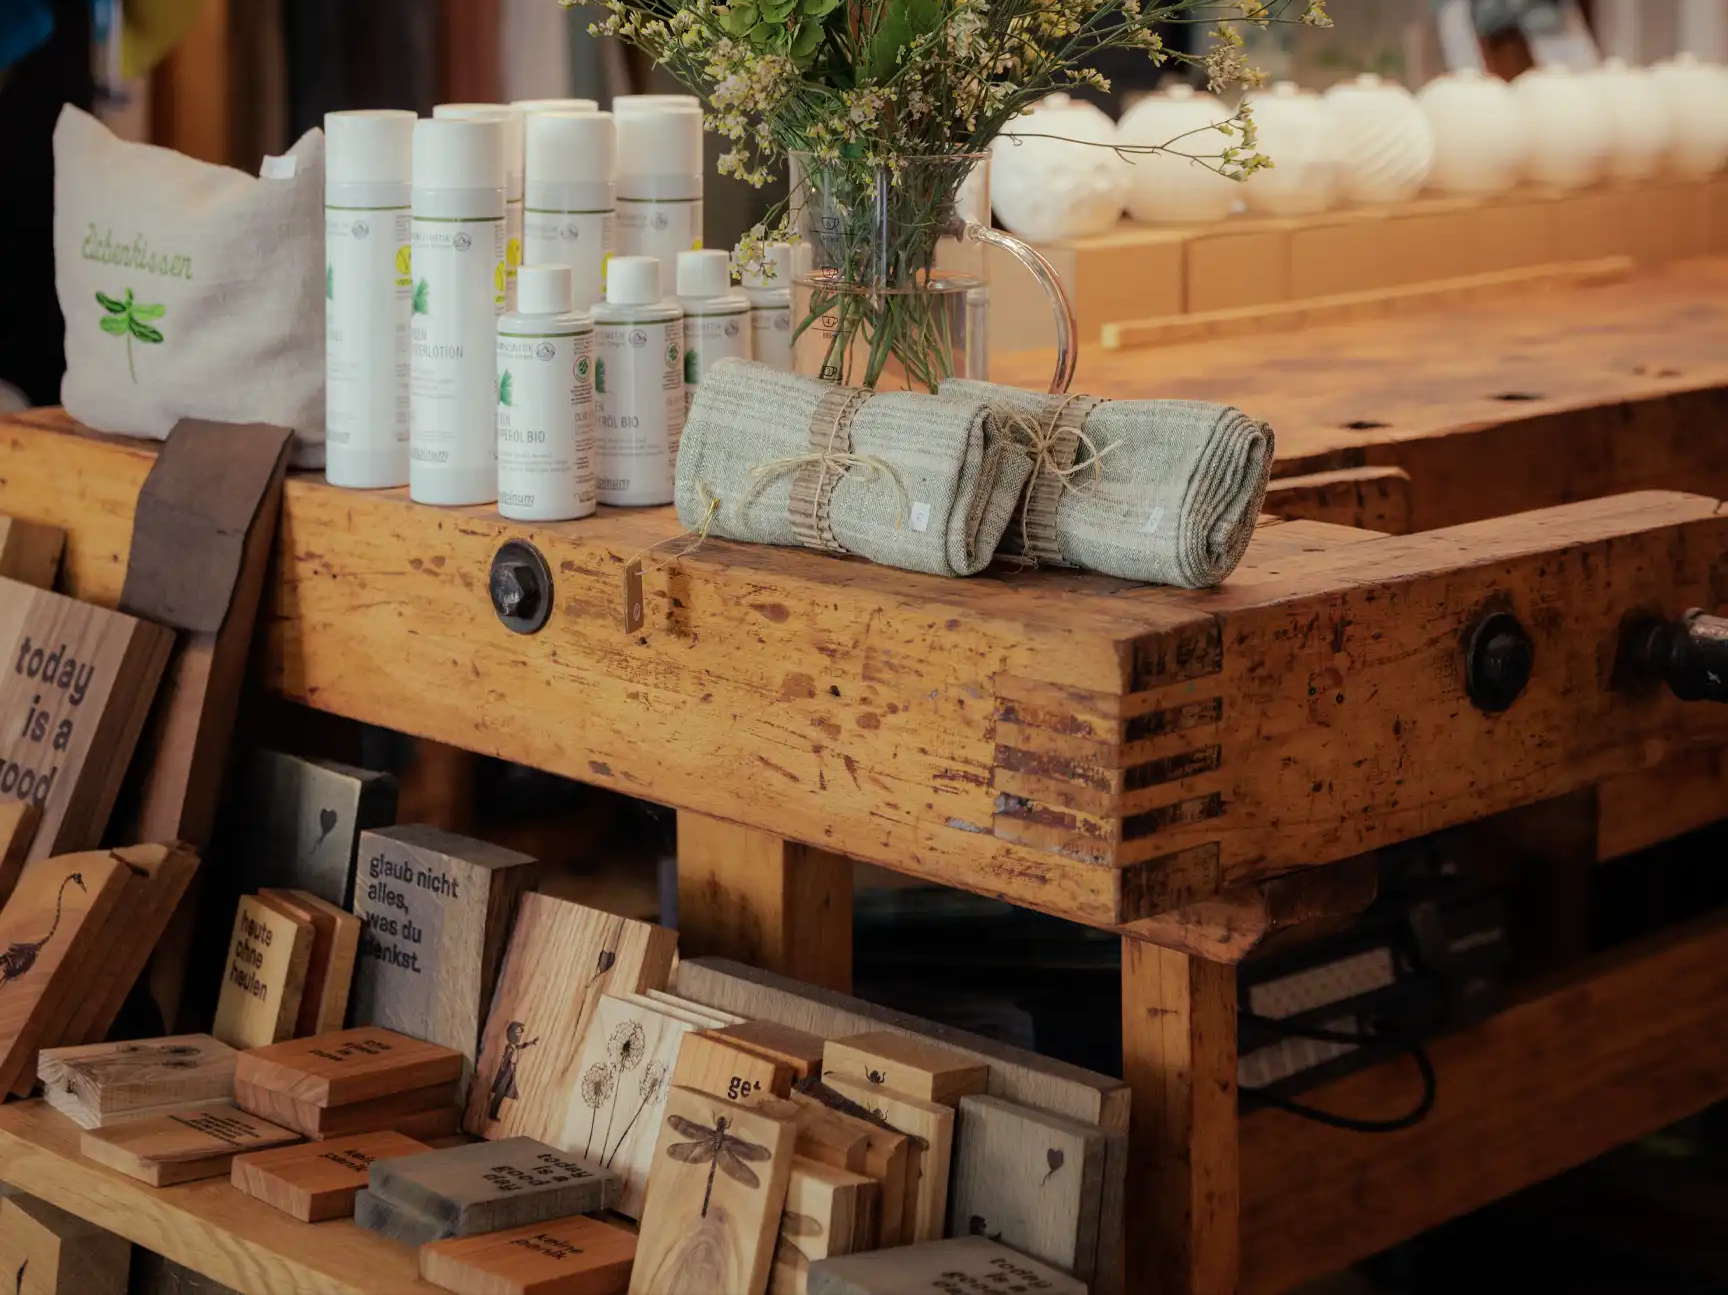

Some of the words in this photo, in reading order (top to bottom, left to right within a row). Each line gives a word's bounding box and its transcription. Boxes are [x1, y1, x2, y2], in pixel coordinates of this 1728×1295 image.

[527, 431, 546, 443] BIO
[621, 416, 640, 428] BIO
[15, 637, 95, 706] today
[22, 694, 50, 743] is
[52, 719, 74, 752] a
[369, 853, 414, 883] glaub
[416, 867, 460, 899] nicht
[367, 881, 409, 914] alles,
[240, 909, 273, 947] heute
[364, 910, 398, 936] was
[402, 919, 422, 945] du
[235, 937, 264, 970] ohne
[364, 935, 422, 974] denkst.
[229, 959, 268, 1002] heulen
[490, 1165, 552, 1186] good
[531, 1166, 554, 1175] is
[536, 1153, 593, 1178] today
[482, 1174, 523, 1191] day
[509, 1238, 567, 1259] panik
[532, 1233, 584, 1255] keine
[989, 1258, 1053, 1289] today
